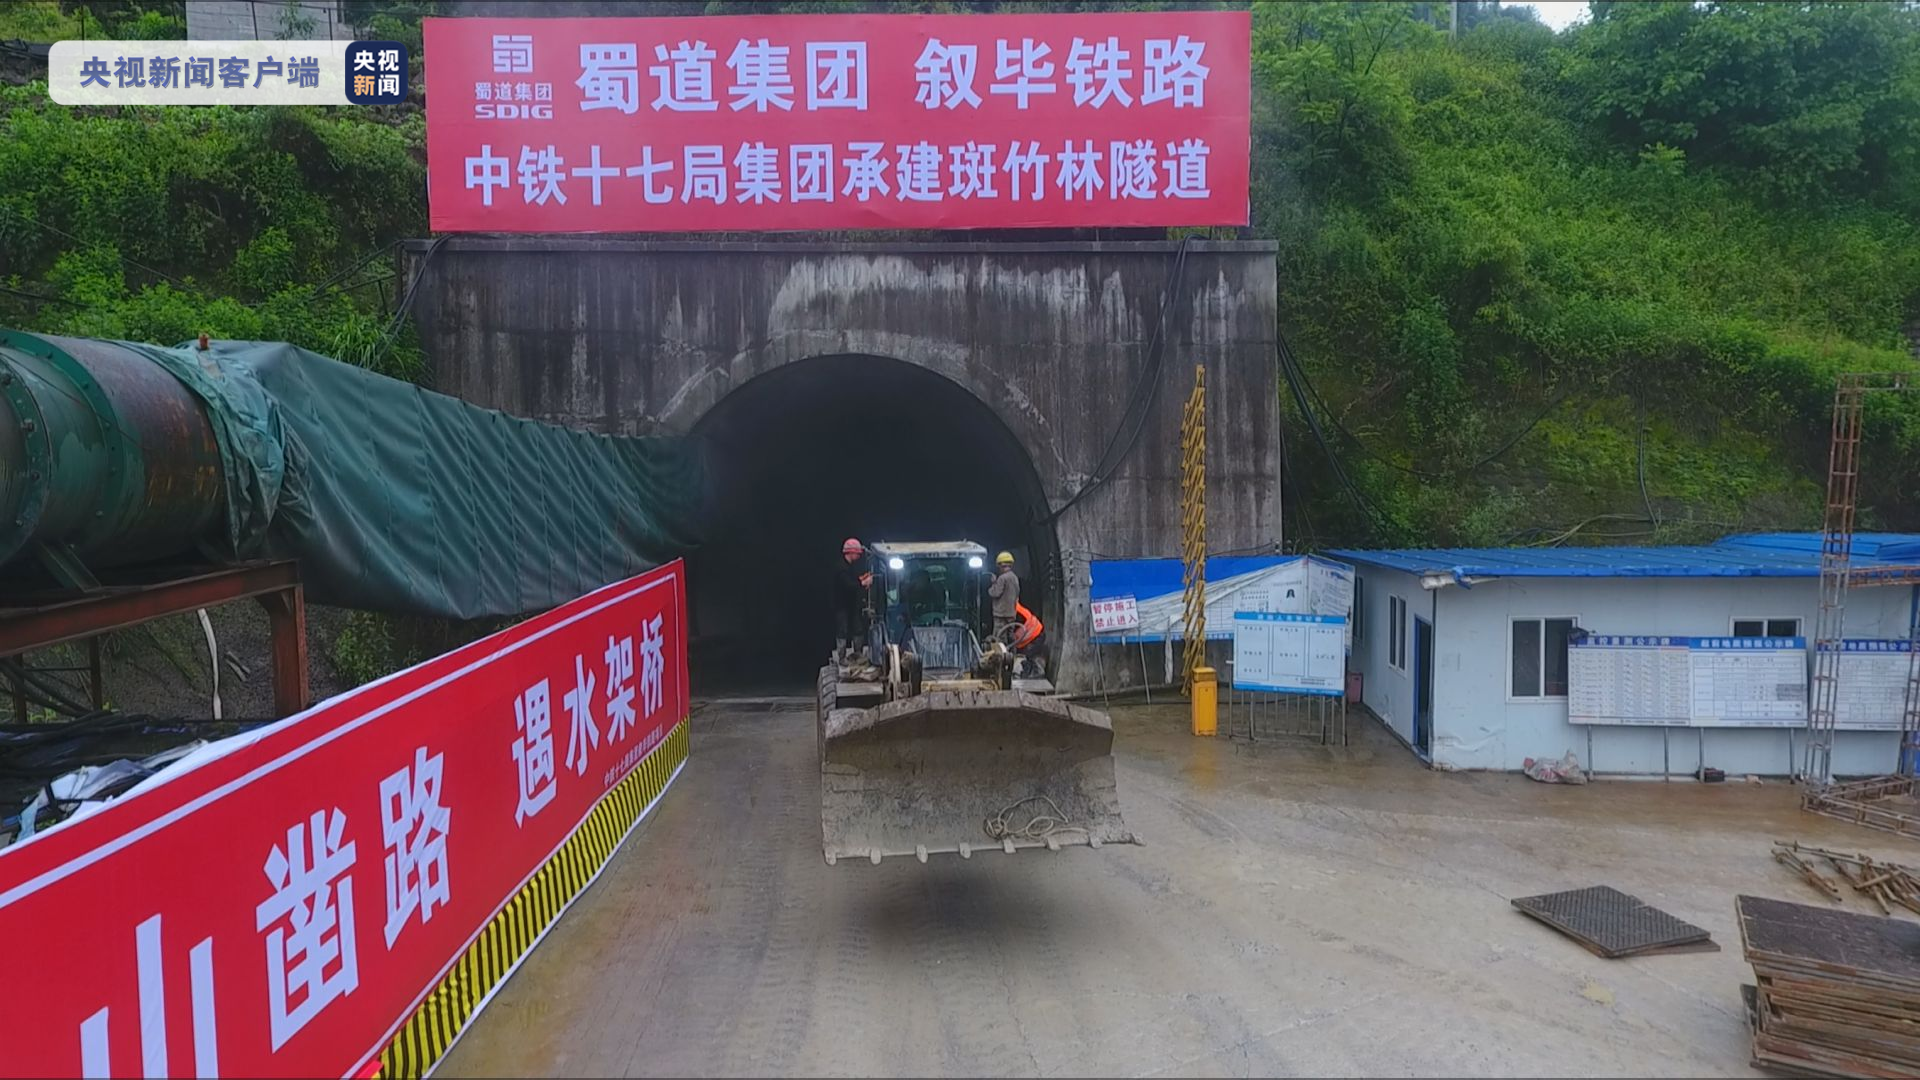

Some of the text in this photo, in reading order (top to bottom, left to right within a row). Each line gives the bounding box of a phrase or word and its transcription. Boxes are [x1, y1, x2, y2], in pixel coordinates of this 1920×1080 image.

[475, 82, 552, 101] 蜀道集团
[574, 34, 1211, 114] 蜀道集团 叙毕铁路
[475, 104, 553, 119] SDIG
[464, 138, 1211, 207] 中铁十七局集团承建斑竹林隧道
[1095, 614, 1138, 628] 禁止进入
[511, 611, 666, 829] 遇水架桥
